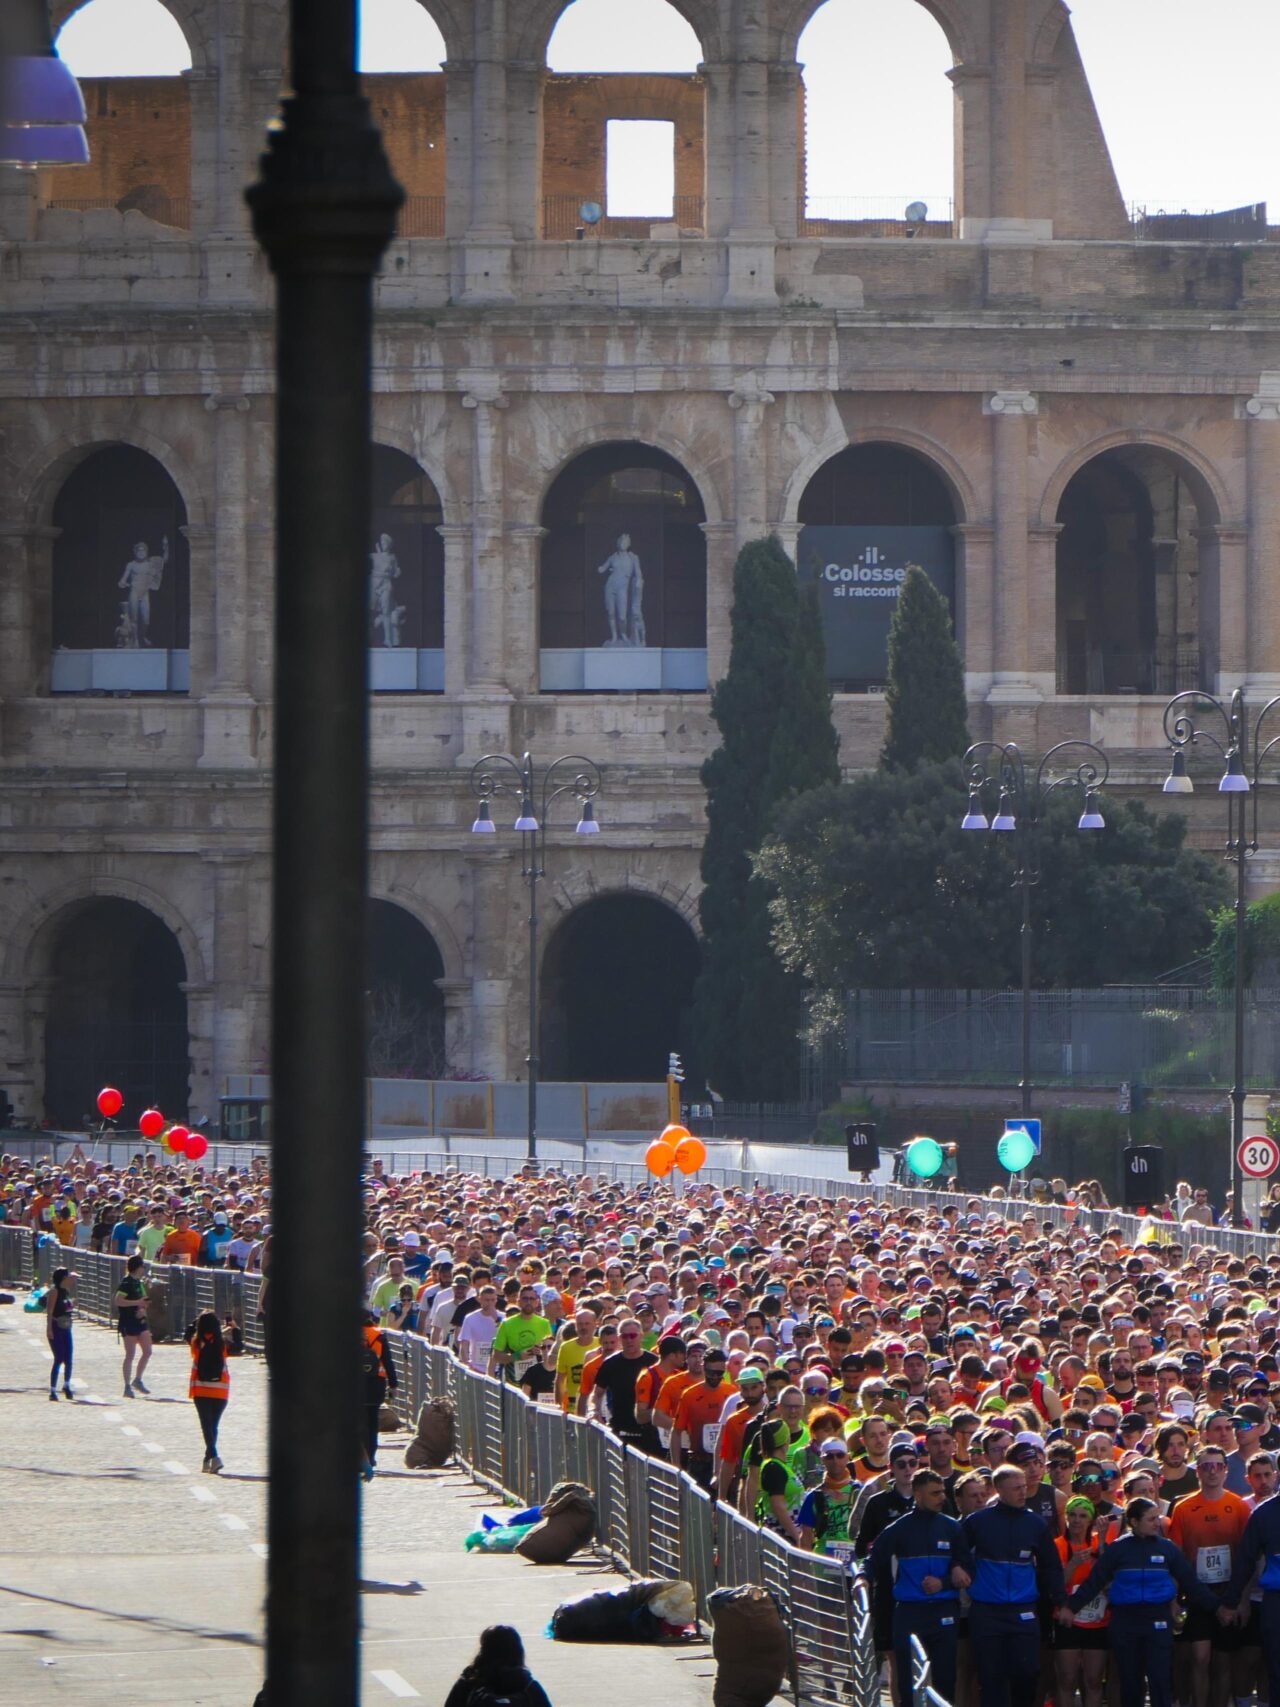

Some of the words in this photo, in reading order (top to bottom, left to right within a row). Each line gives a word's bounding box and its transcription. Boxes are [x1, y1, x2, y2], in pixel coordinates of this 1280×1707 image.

[824, 564, 906, 582] Colosse
[833, 585, 846, 597] si
[849, 585, 901, 597] raccont
[1131, 1155, 1148, 1174] dn
[1248, 1147, 1270, 1166] 30
[1206, 1555, 1221, 1569] 874
